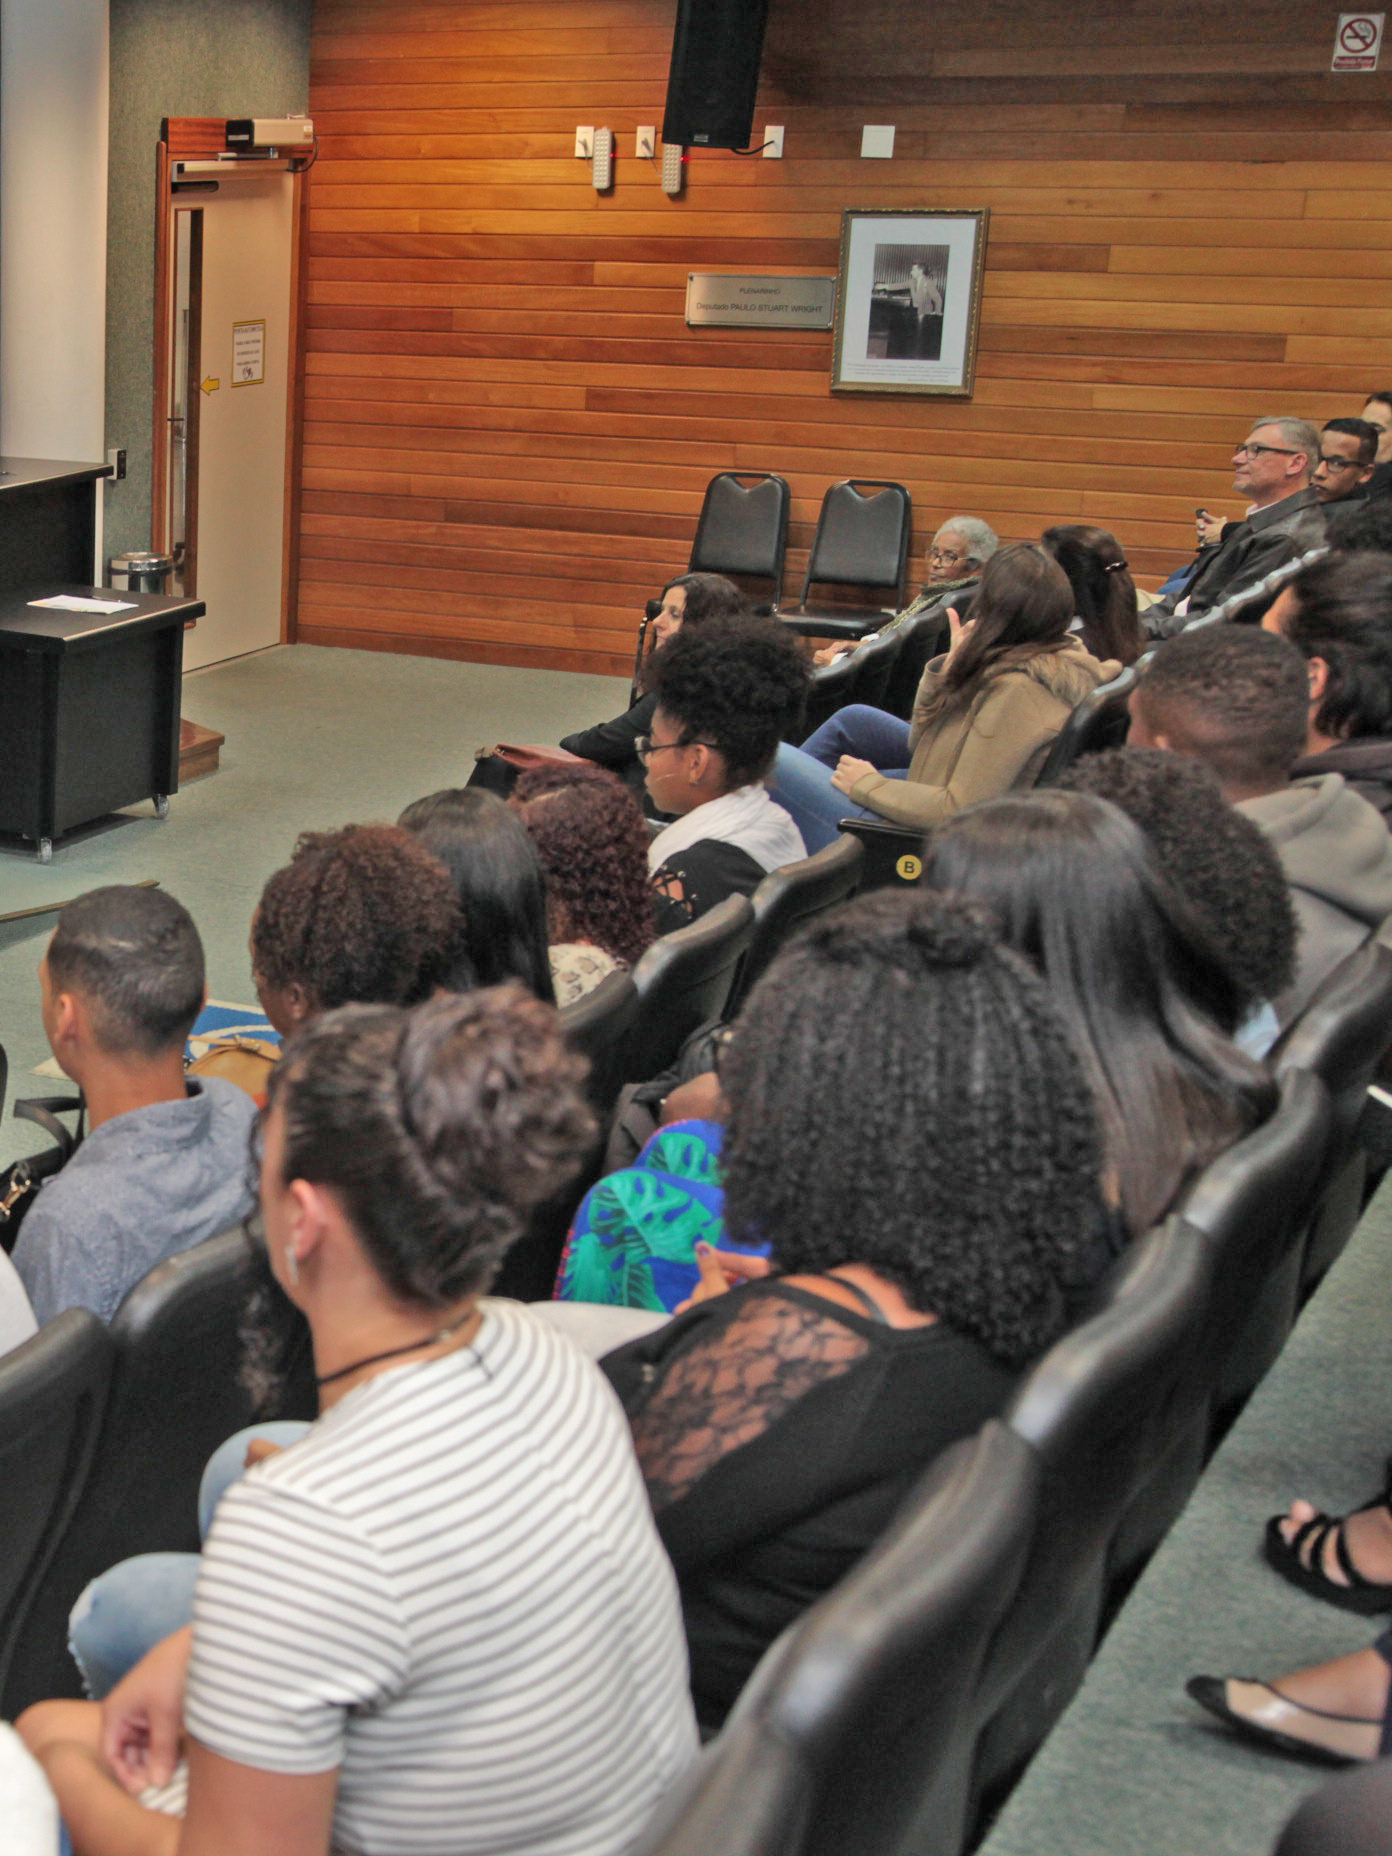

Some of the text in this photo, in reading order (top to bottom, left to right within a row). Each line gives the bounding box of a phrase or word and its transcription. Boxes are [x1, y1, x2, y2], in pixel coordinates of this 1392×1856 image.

[696, 302, 823, 313] Deputado PAULO STUART WRIGHT
[904, 861, 915, 873] B
